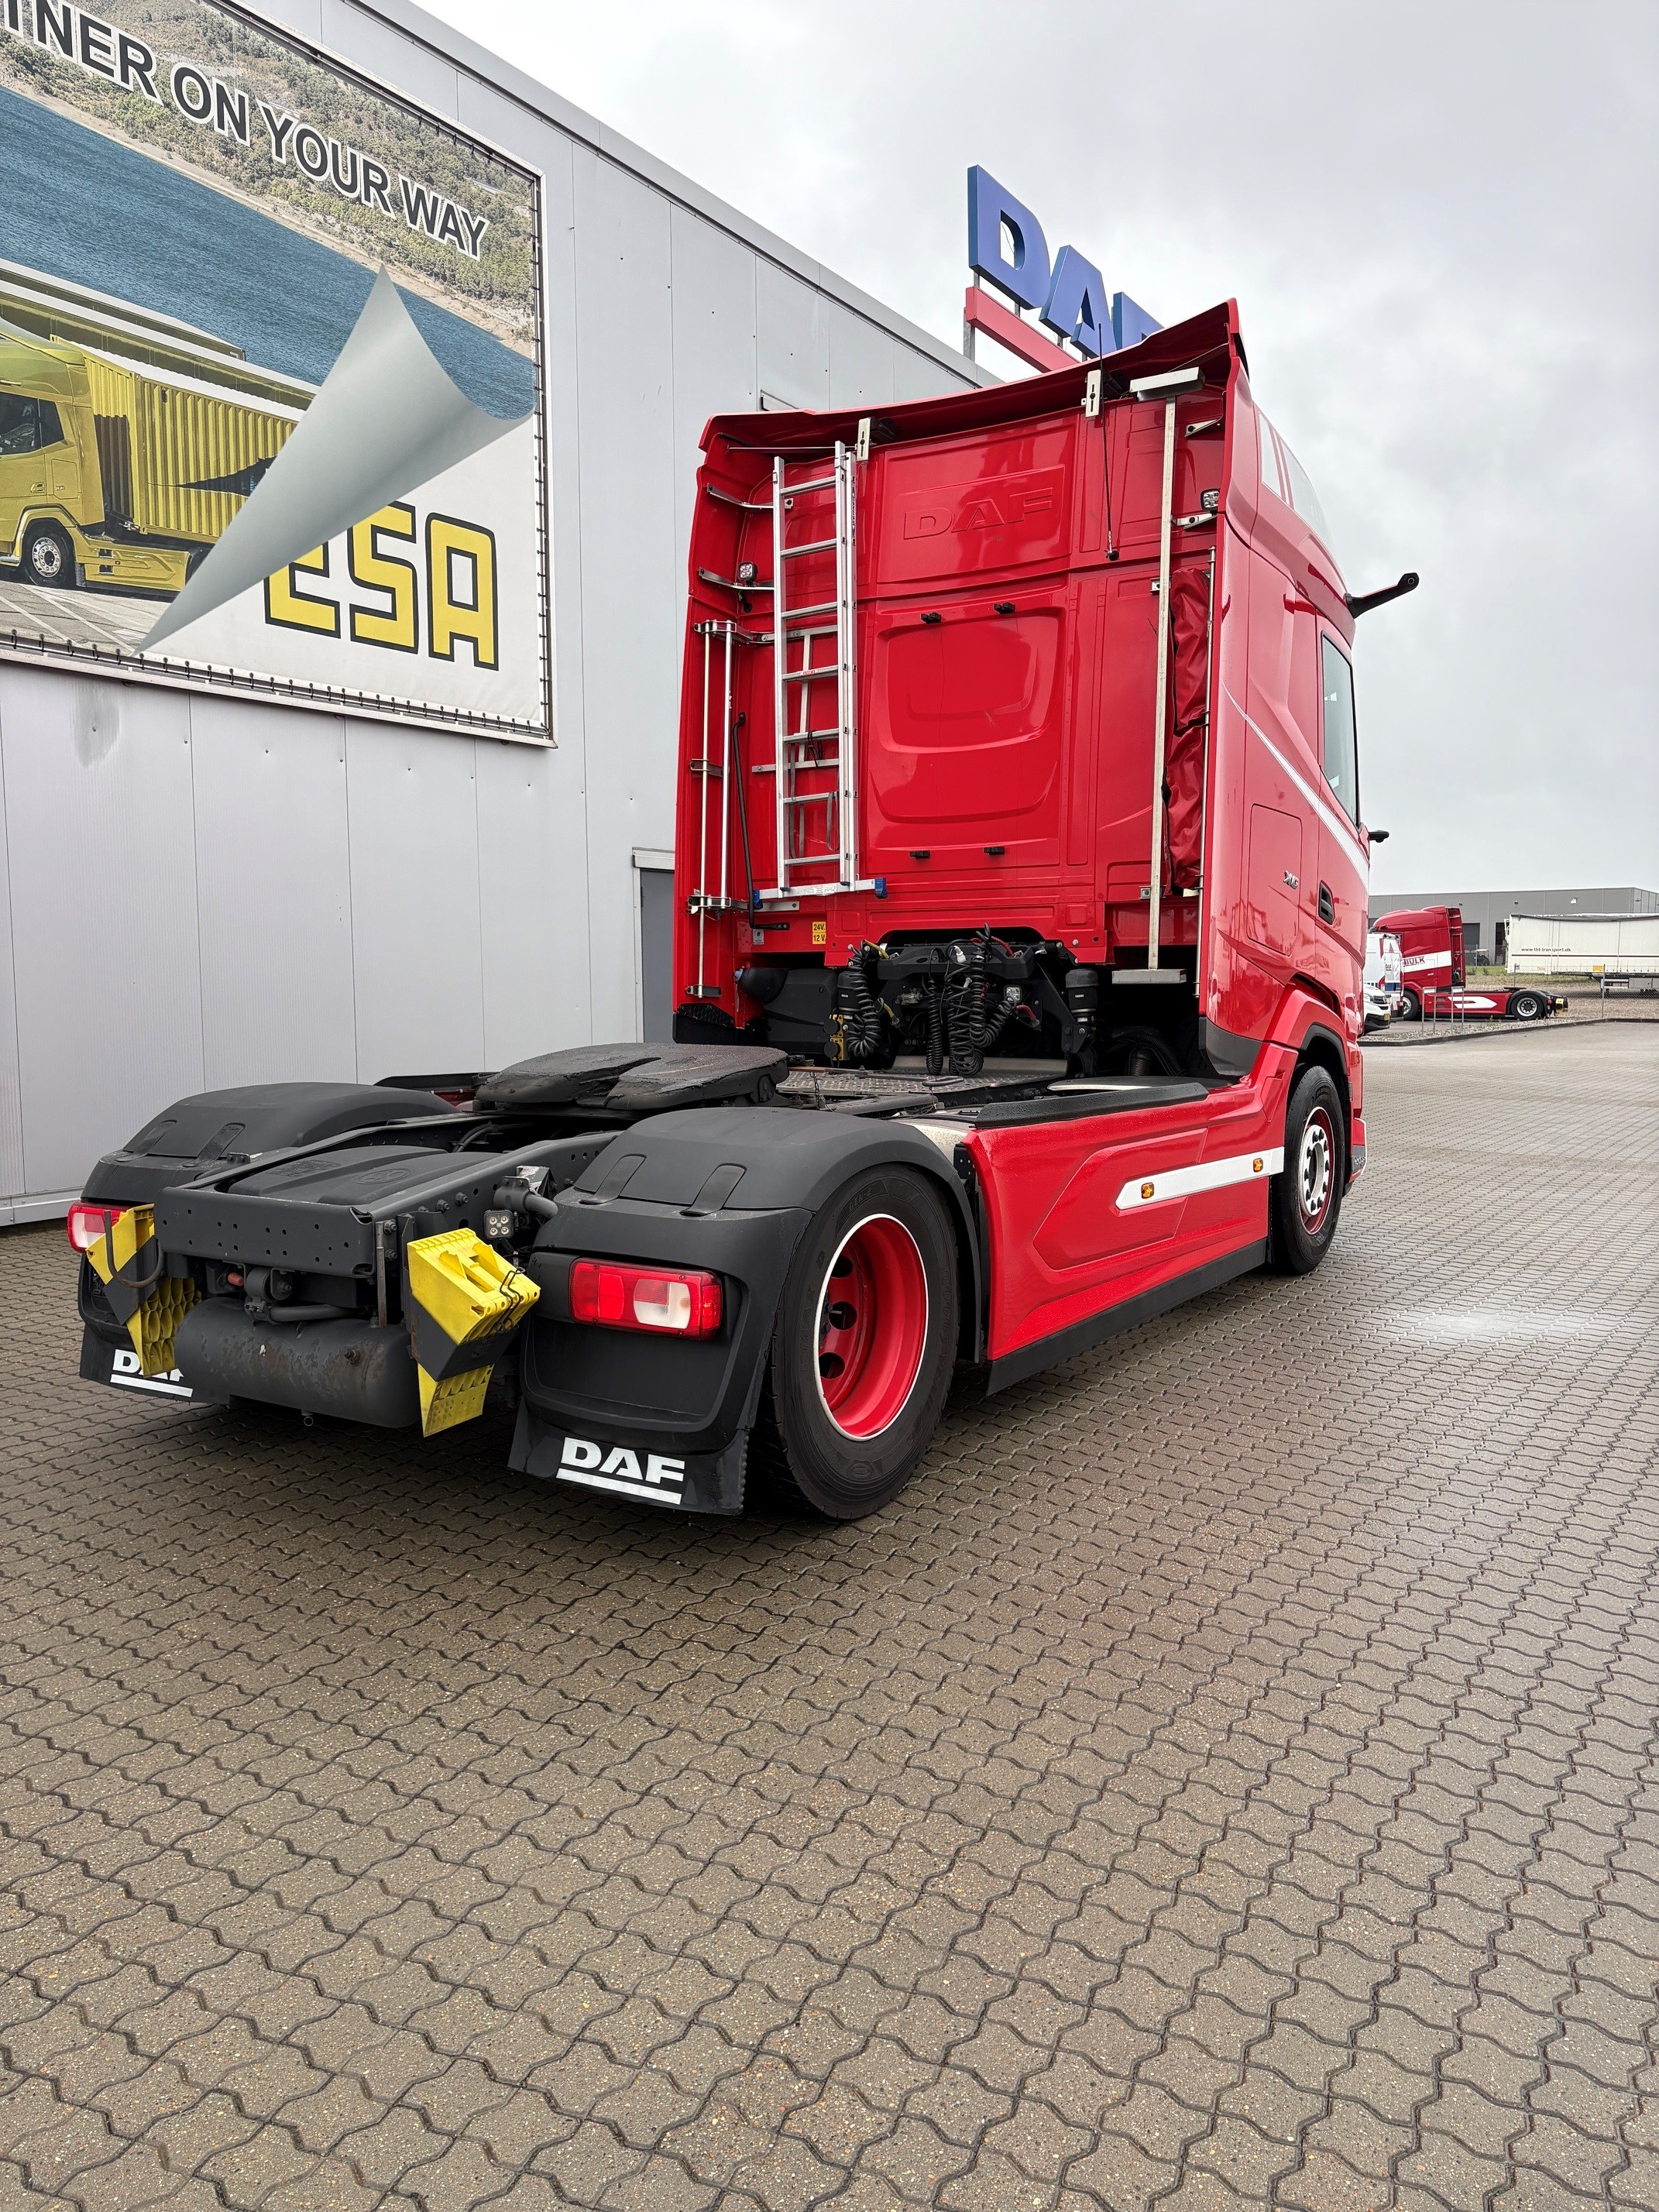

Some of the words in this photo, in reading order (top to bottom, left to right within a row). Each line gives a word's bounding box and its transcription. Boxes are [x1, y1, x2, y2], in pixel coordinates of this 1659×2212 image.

[172, 63, 249, 146] ON
[259, 101, 394, 218] YOUR
[399, 174, 488, 260] WAY
[904, 487, 1053, 540] DAF
[561, 1437, 685, 1484] DAF
